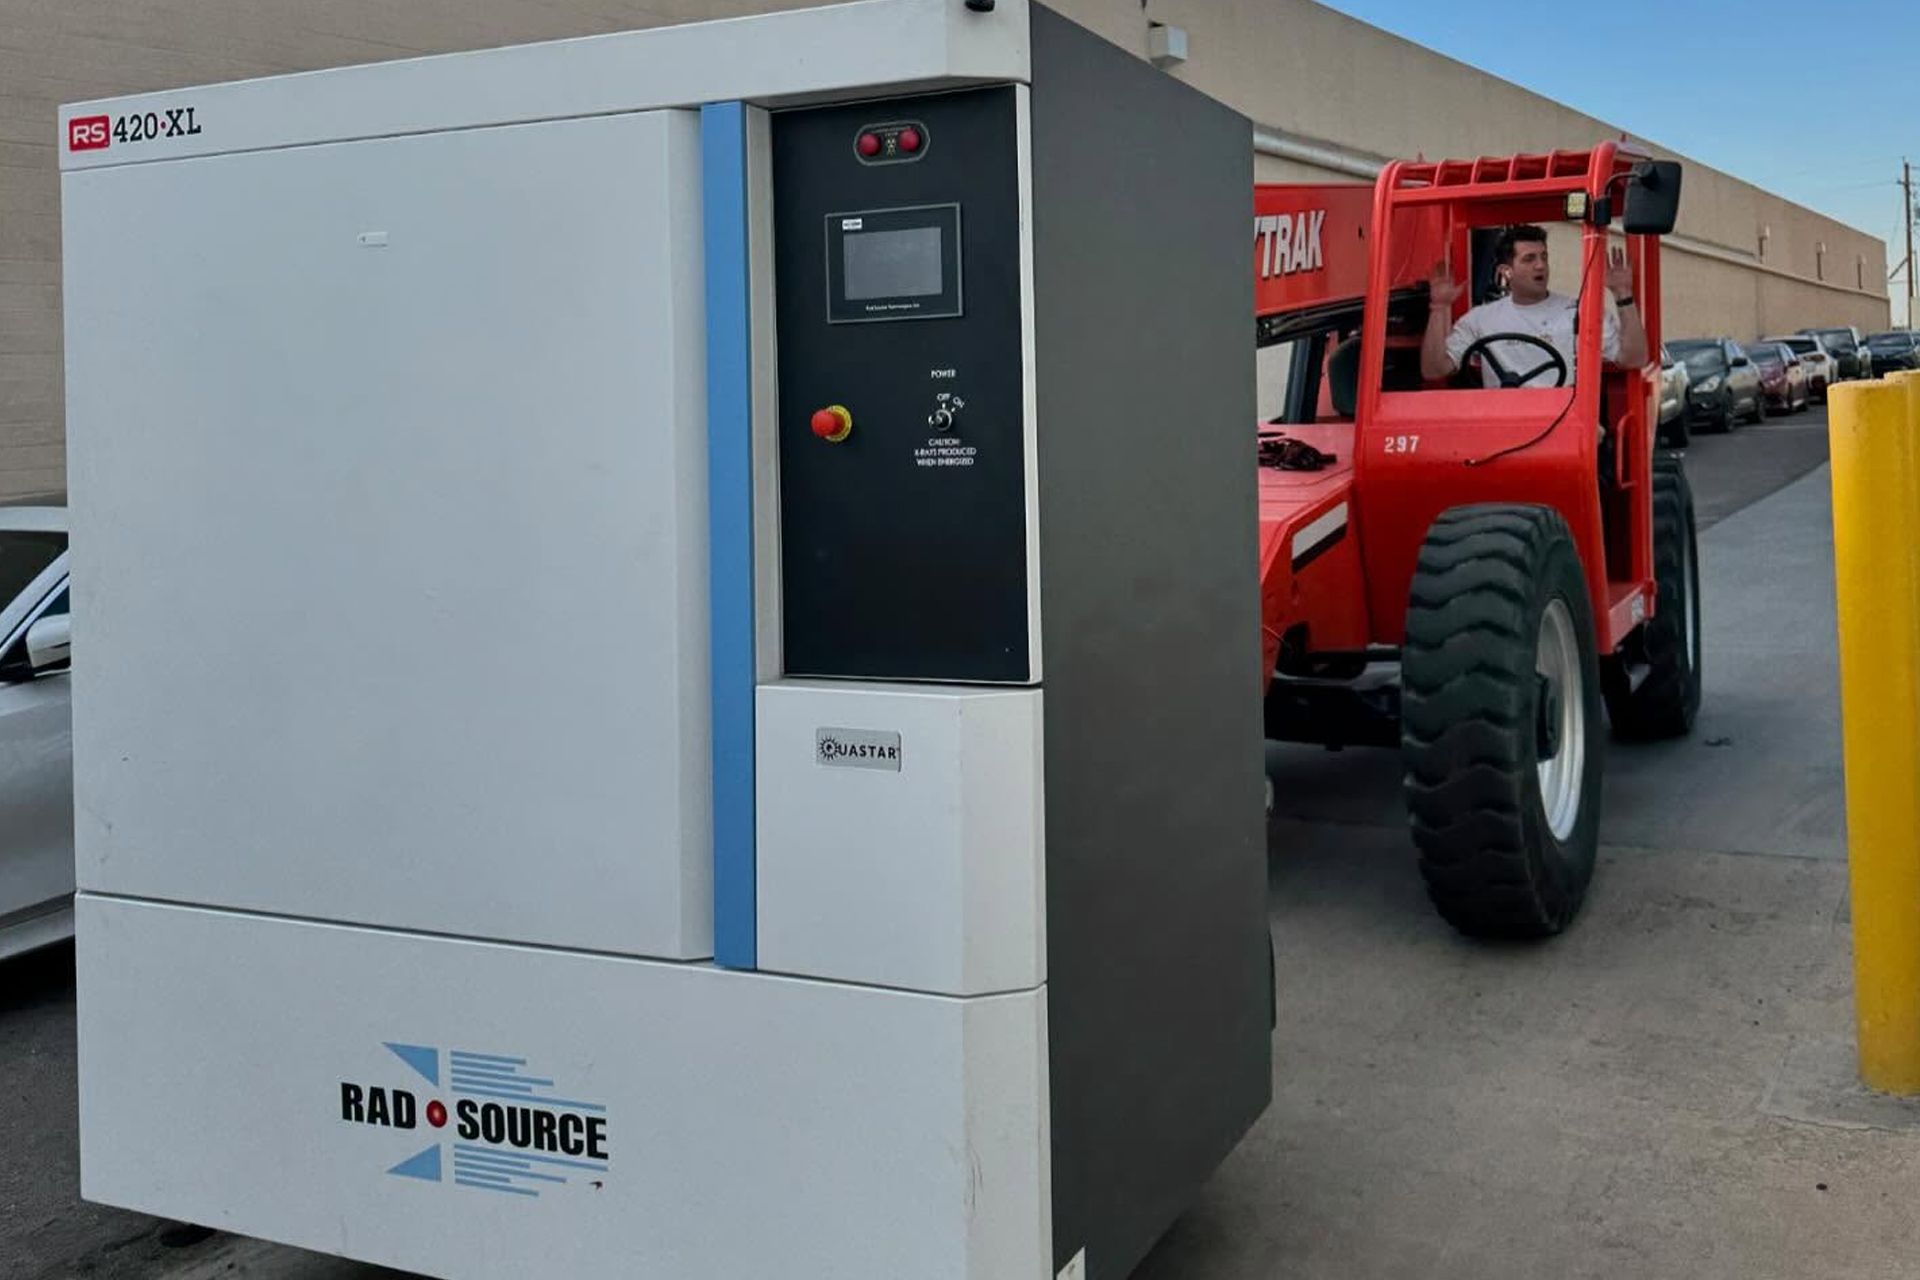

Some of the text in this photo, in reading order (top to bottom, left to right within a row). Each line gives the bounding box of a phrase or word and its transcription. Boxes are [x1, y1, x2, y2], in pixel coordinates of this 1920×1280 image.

[73, 123, 106, 145] RS
[938, 447, 977, 456] PRODUCED
[1384, 435, 1419, 453] 297
[341, 1082, 609, 1160] RAD SOURCE
